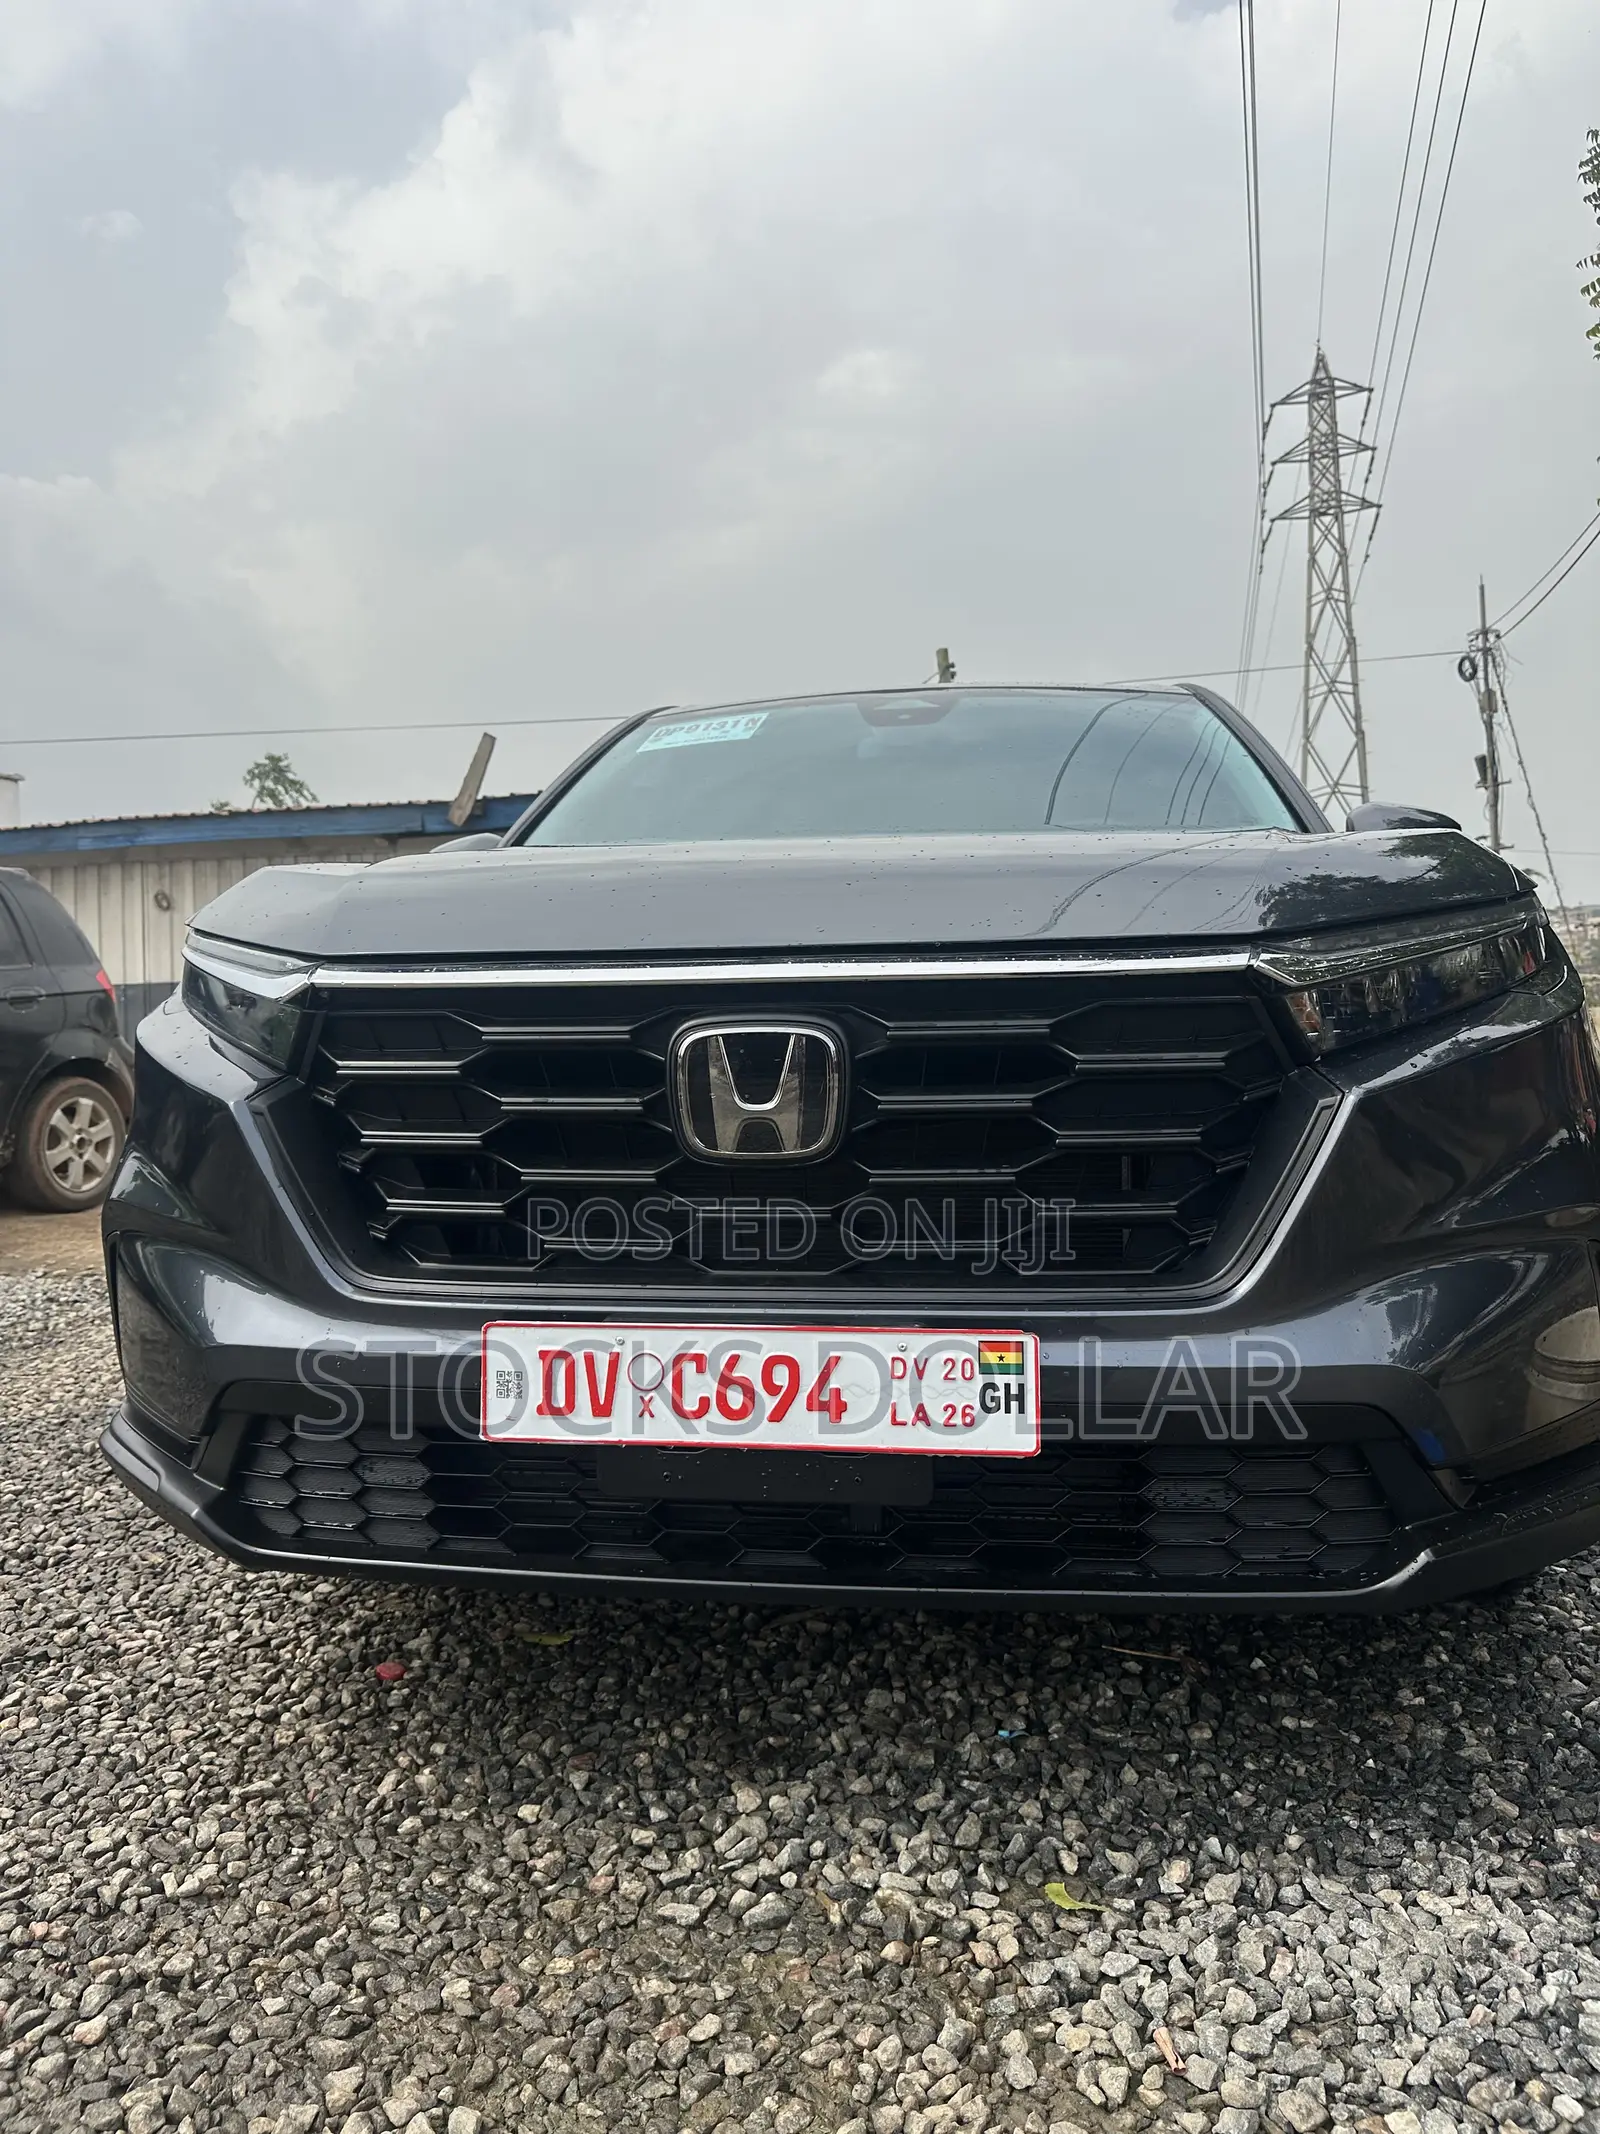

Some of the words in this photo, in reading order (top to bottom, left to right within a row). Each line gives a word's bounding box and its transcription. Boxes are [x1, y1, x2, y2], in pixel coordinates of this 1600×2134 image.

[890, 1356, 929, 1381] DV
[942, 1357, 975, 1381] 20
[536, 1350, 620, 1417] DV
[671, 1352, 848, 1424] C694
[979, 1382, 1026, 1415] GH
[890, 1402, 931, 1427] LA
[942, 1403, 976, 1428] 26
